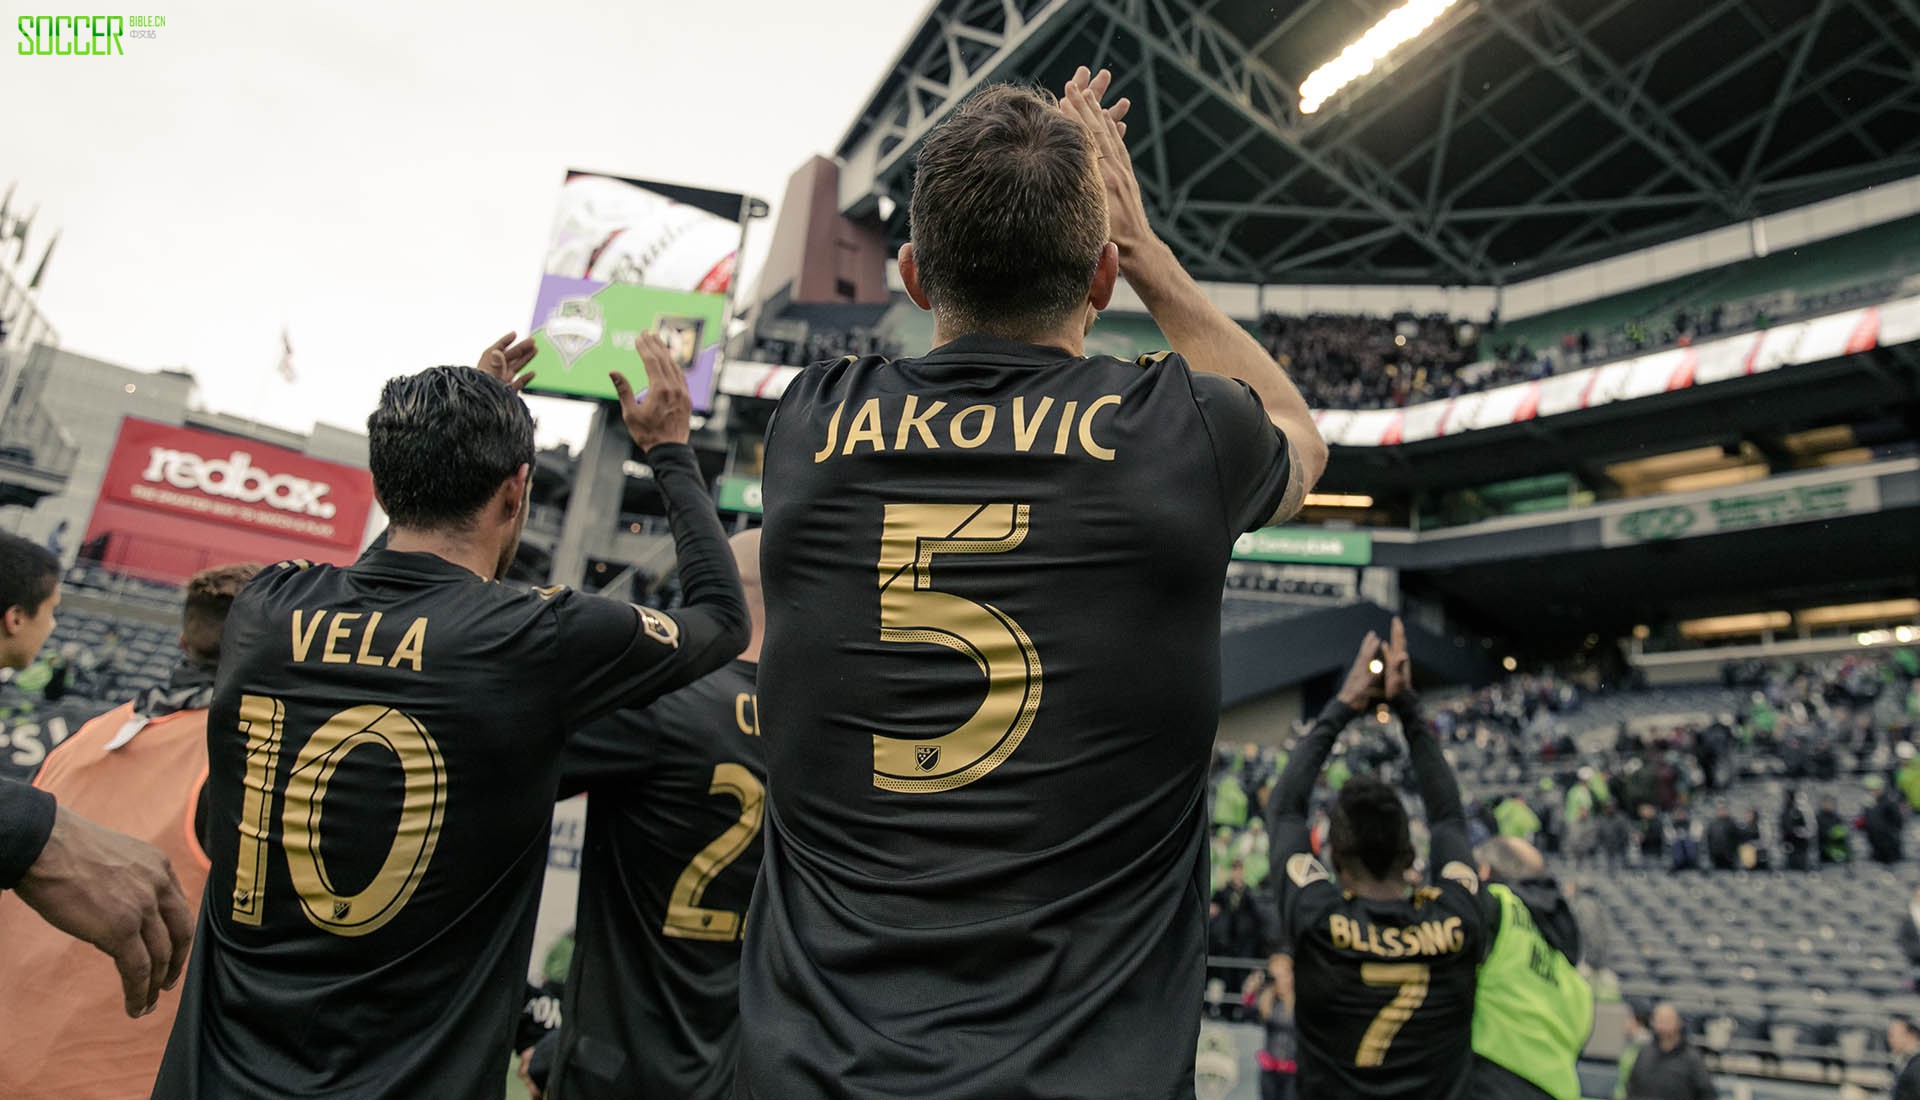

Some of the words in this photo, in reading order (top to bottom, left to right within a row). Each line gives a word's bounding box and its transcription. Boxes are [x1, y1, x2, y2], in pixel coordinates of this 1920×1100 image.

[814, 395, 1123, 462] JAKOVIC
[291, 608, 429, 671] VELA
[873, 503, 1044, 794] 5
[232, 694, 447, 938] 10
[662, 762, 767, 942] 2
[1354, 962, 1430, 1068] 7
